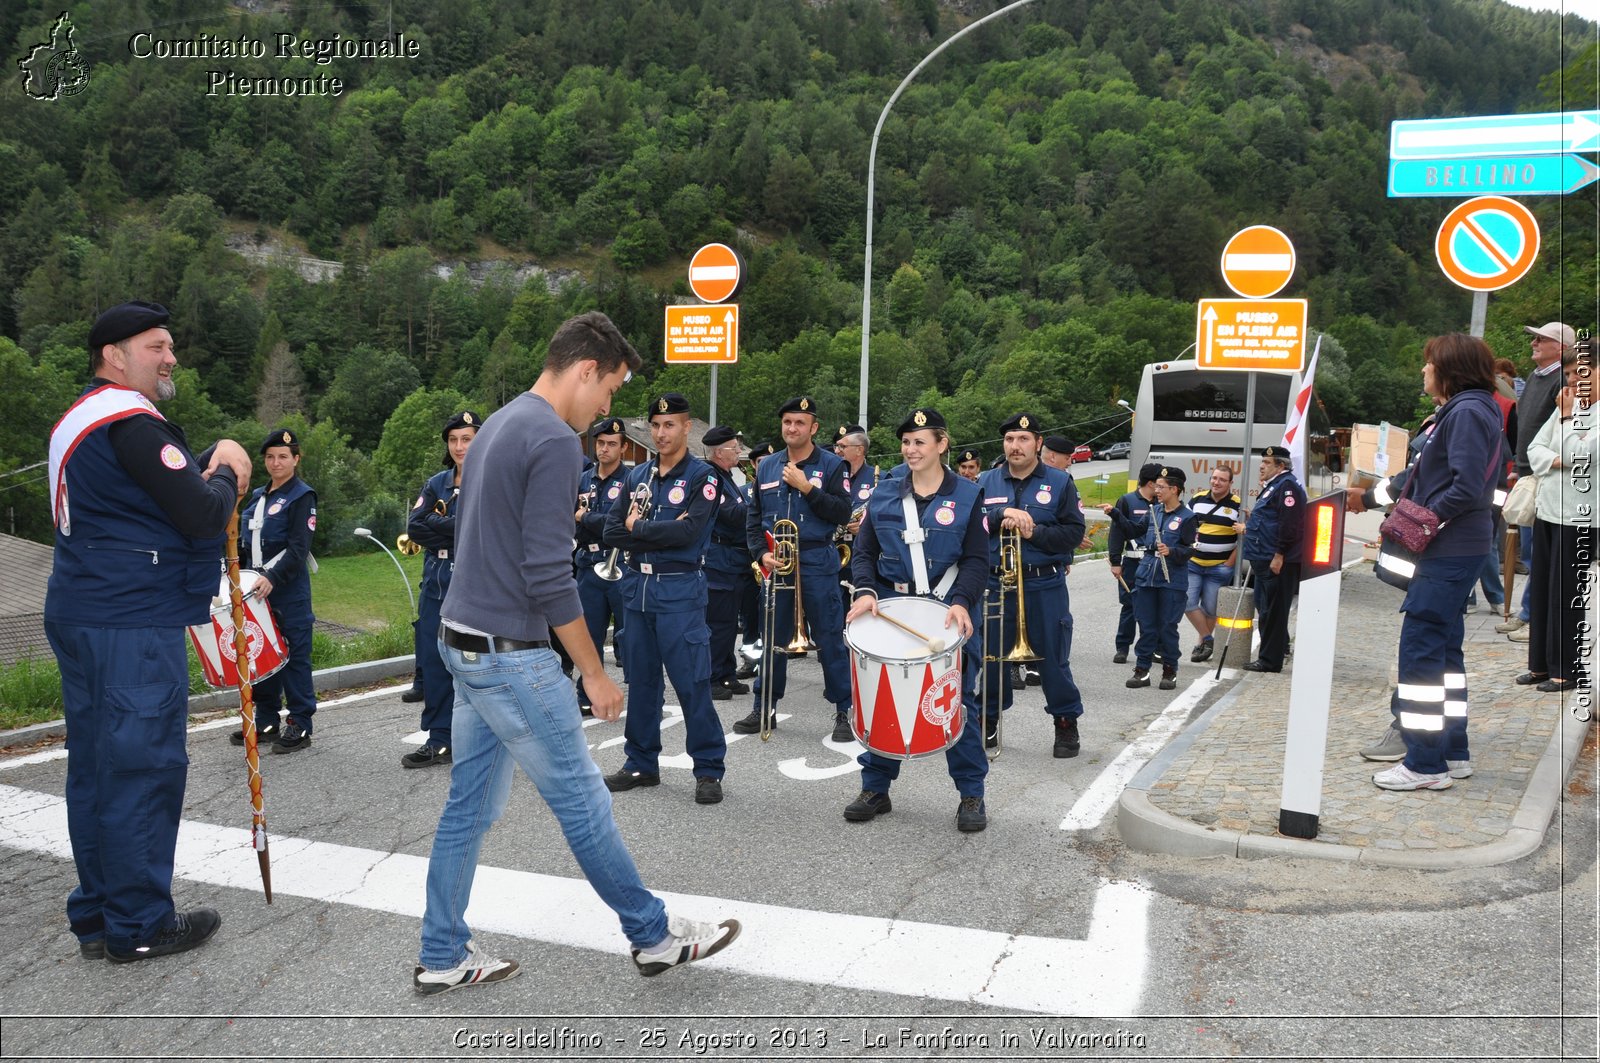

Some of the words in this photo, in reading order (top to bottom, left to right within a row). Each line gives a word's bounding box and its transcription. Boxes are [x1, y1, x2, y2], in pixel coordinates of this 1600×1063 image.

[1425, 164, 1536, 187] BELLINO
[682, 315, 711, 325] MUSEO
[1236, 312, 1278, 323] MUSEO
[670, 326, 682, 336] EN
[683, 326, 707, 335] PLEIN
[709, 325, 724, 335] AIR
[1217, 325, 1235, 336] EN
[1238, 325, 1273, 336] PLEIN
[1276, 326, 1298, 337] AIR
[930, 685, 937, 693] DI
